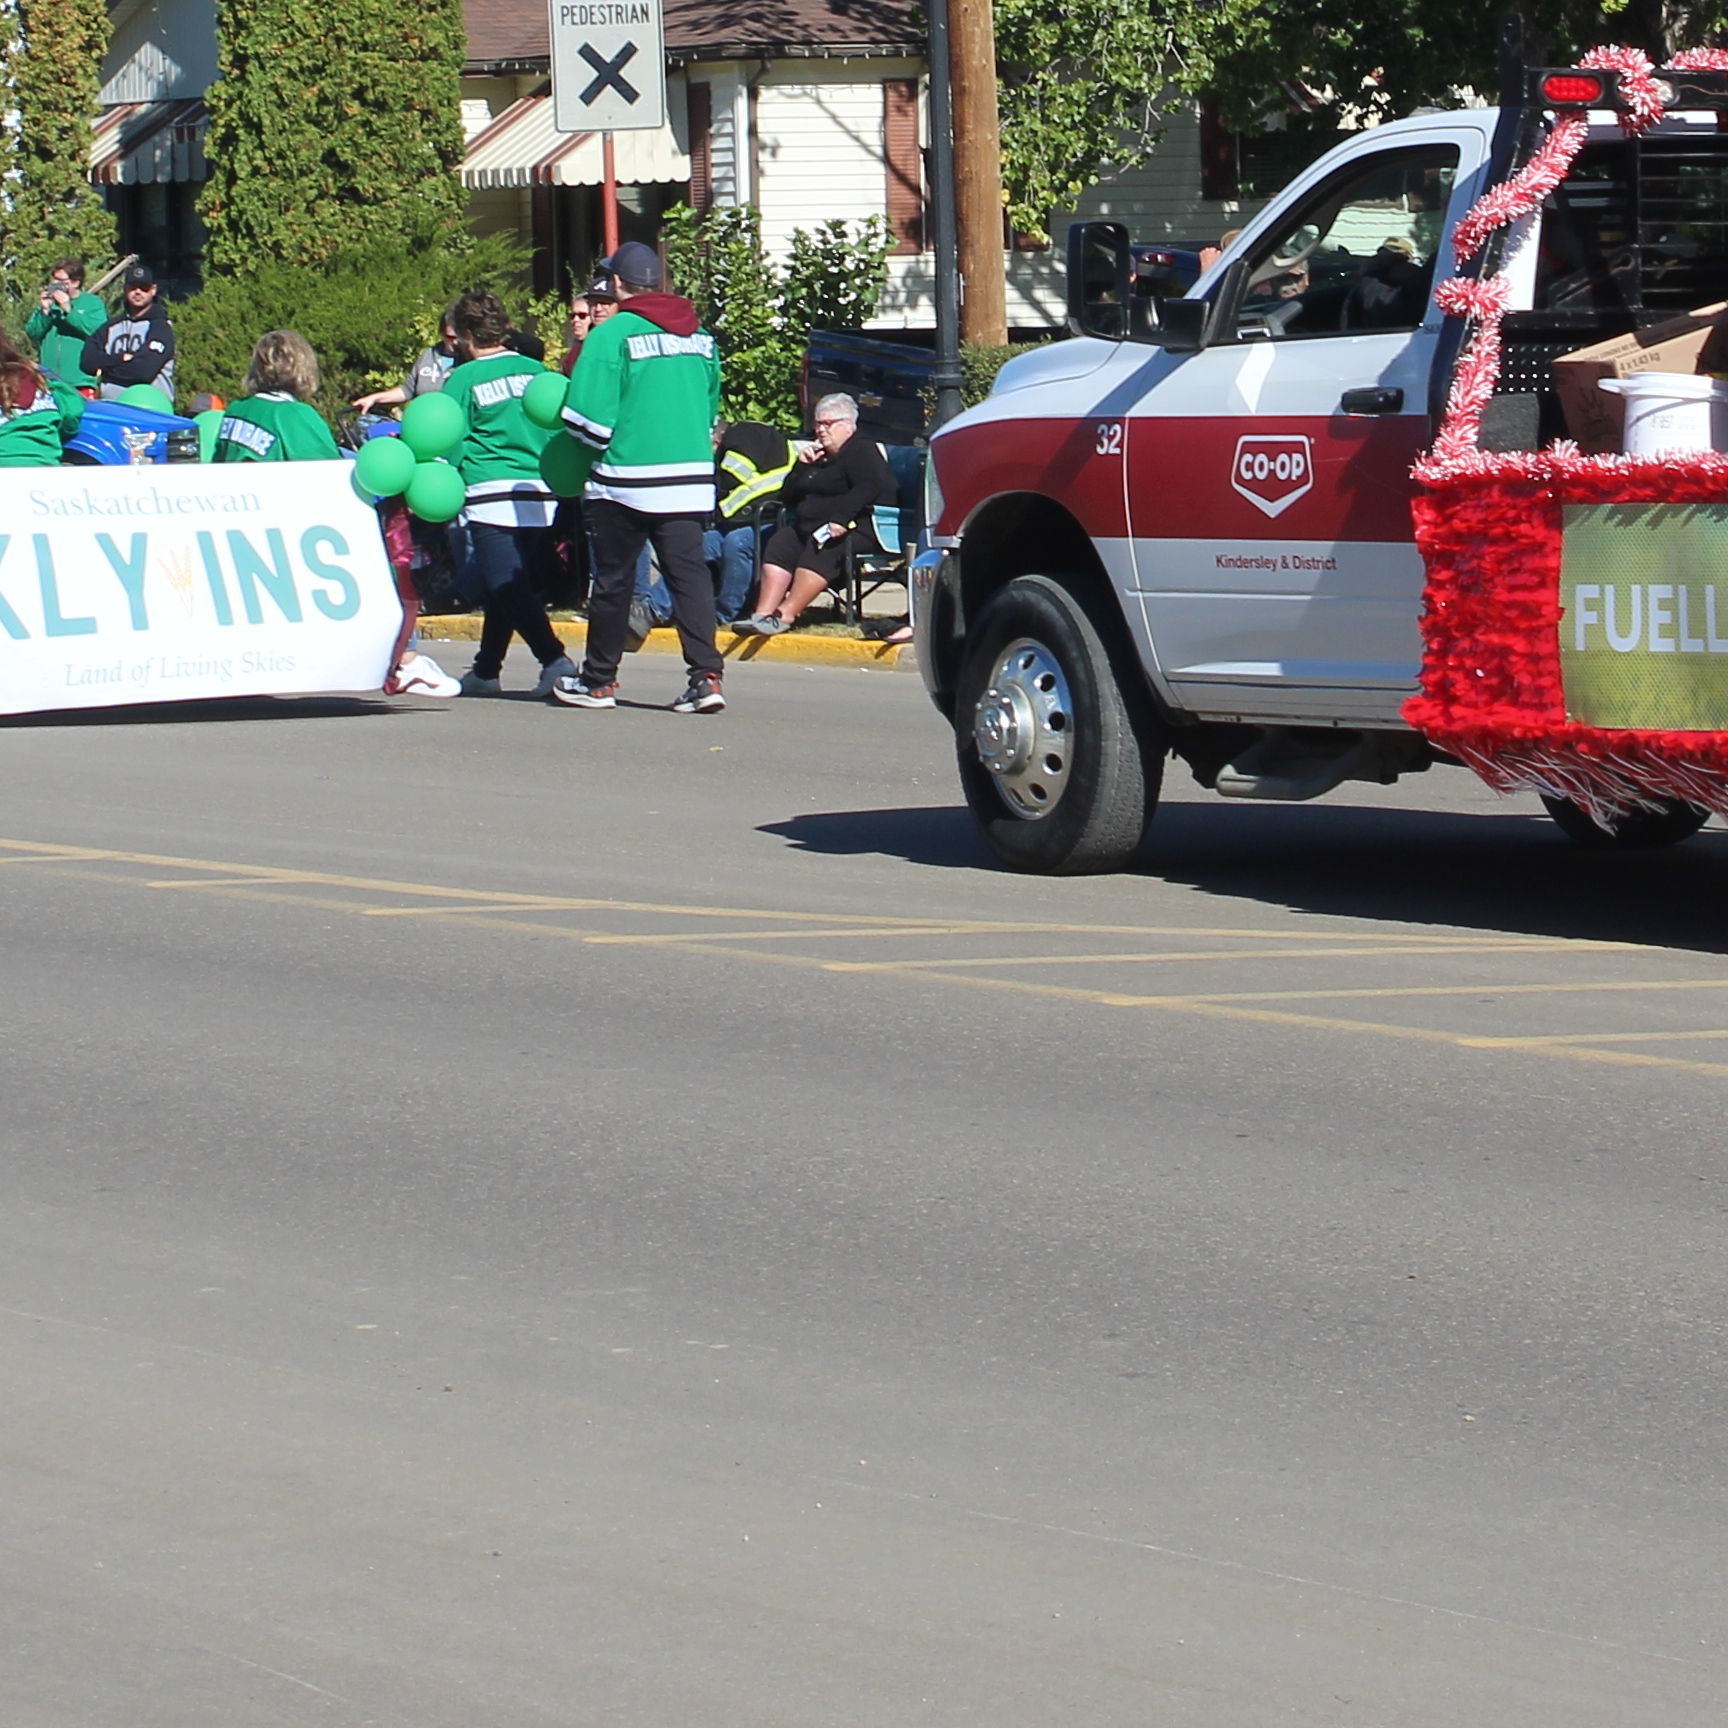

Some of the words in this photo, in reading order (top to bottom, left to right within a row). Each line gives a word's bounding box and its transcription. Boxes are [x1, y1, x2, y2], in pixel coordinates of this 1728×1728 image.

[561, 3, 650, 25] PEDESTRIAN
[473, 376, 509, 406] KELLY
[1096, 423, 1122, 455] 32
[1239, 453, 1305, 480] CO-OP
[29, 485, 262, 517] Saskatchewan
[196, 524, 361, 626] INS
[1216, 554, 1277, 571] Kindersley
[1280, 555, 1289, 569] &
[1293, 555, 1337, 570] District
[64, 662, 123, 687] Land
[131, 657, 156, 689] of
[159, 654, 237, 685] Living
[241, 649, 297, 674] Skies
